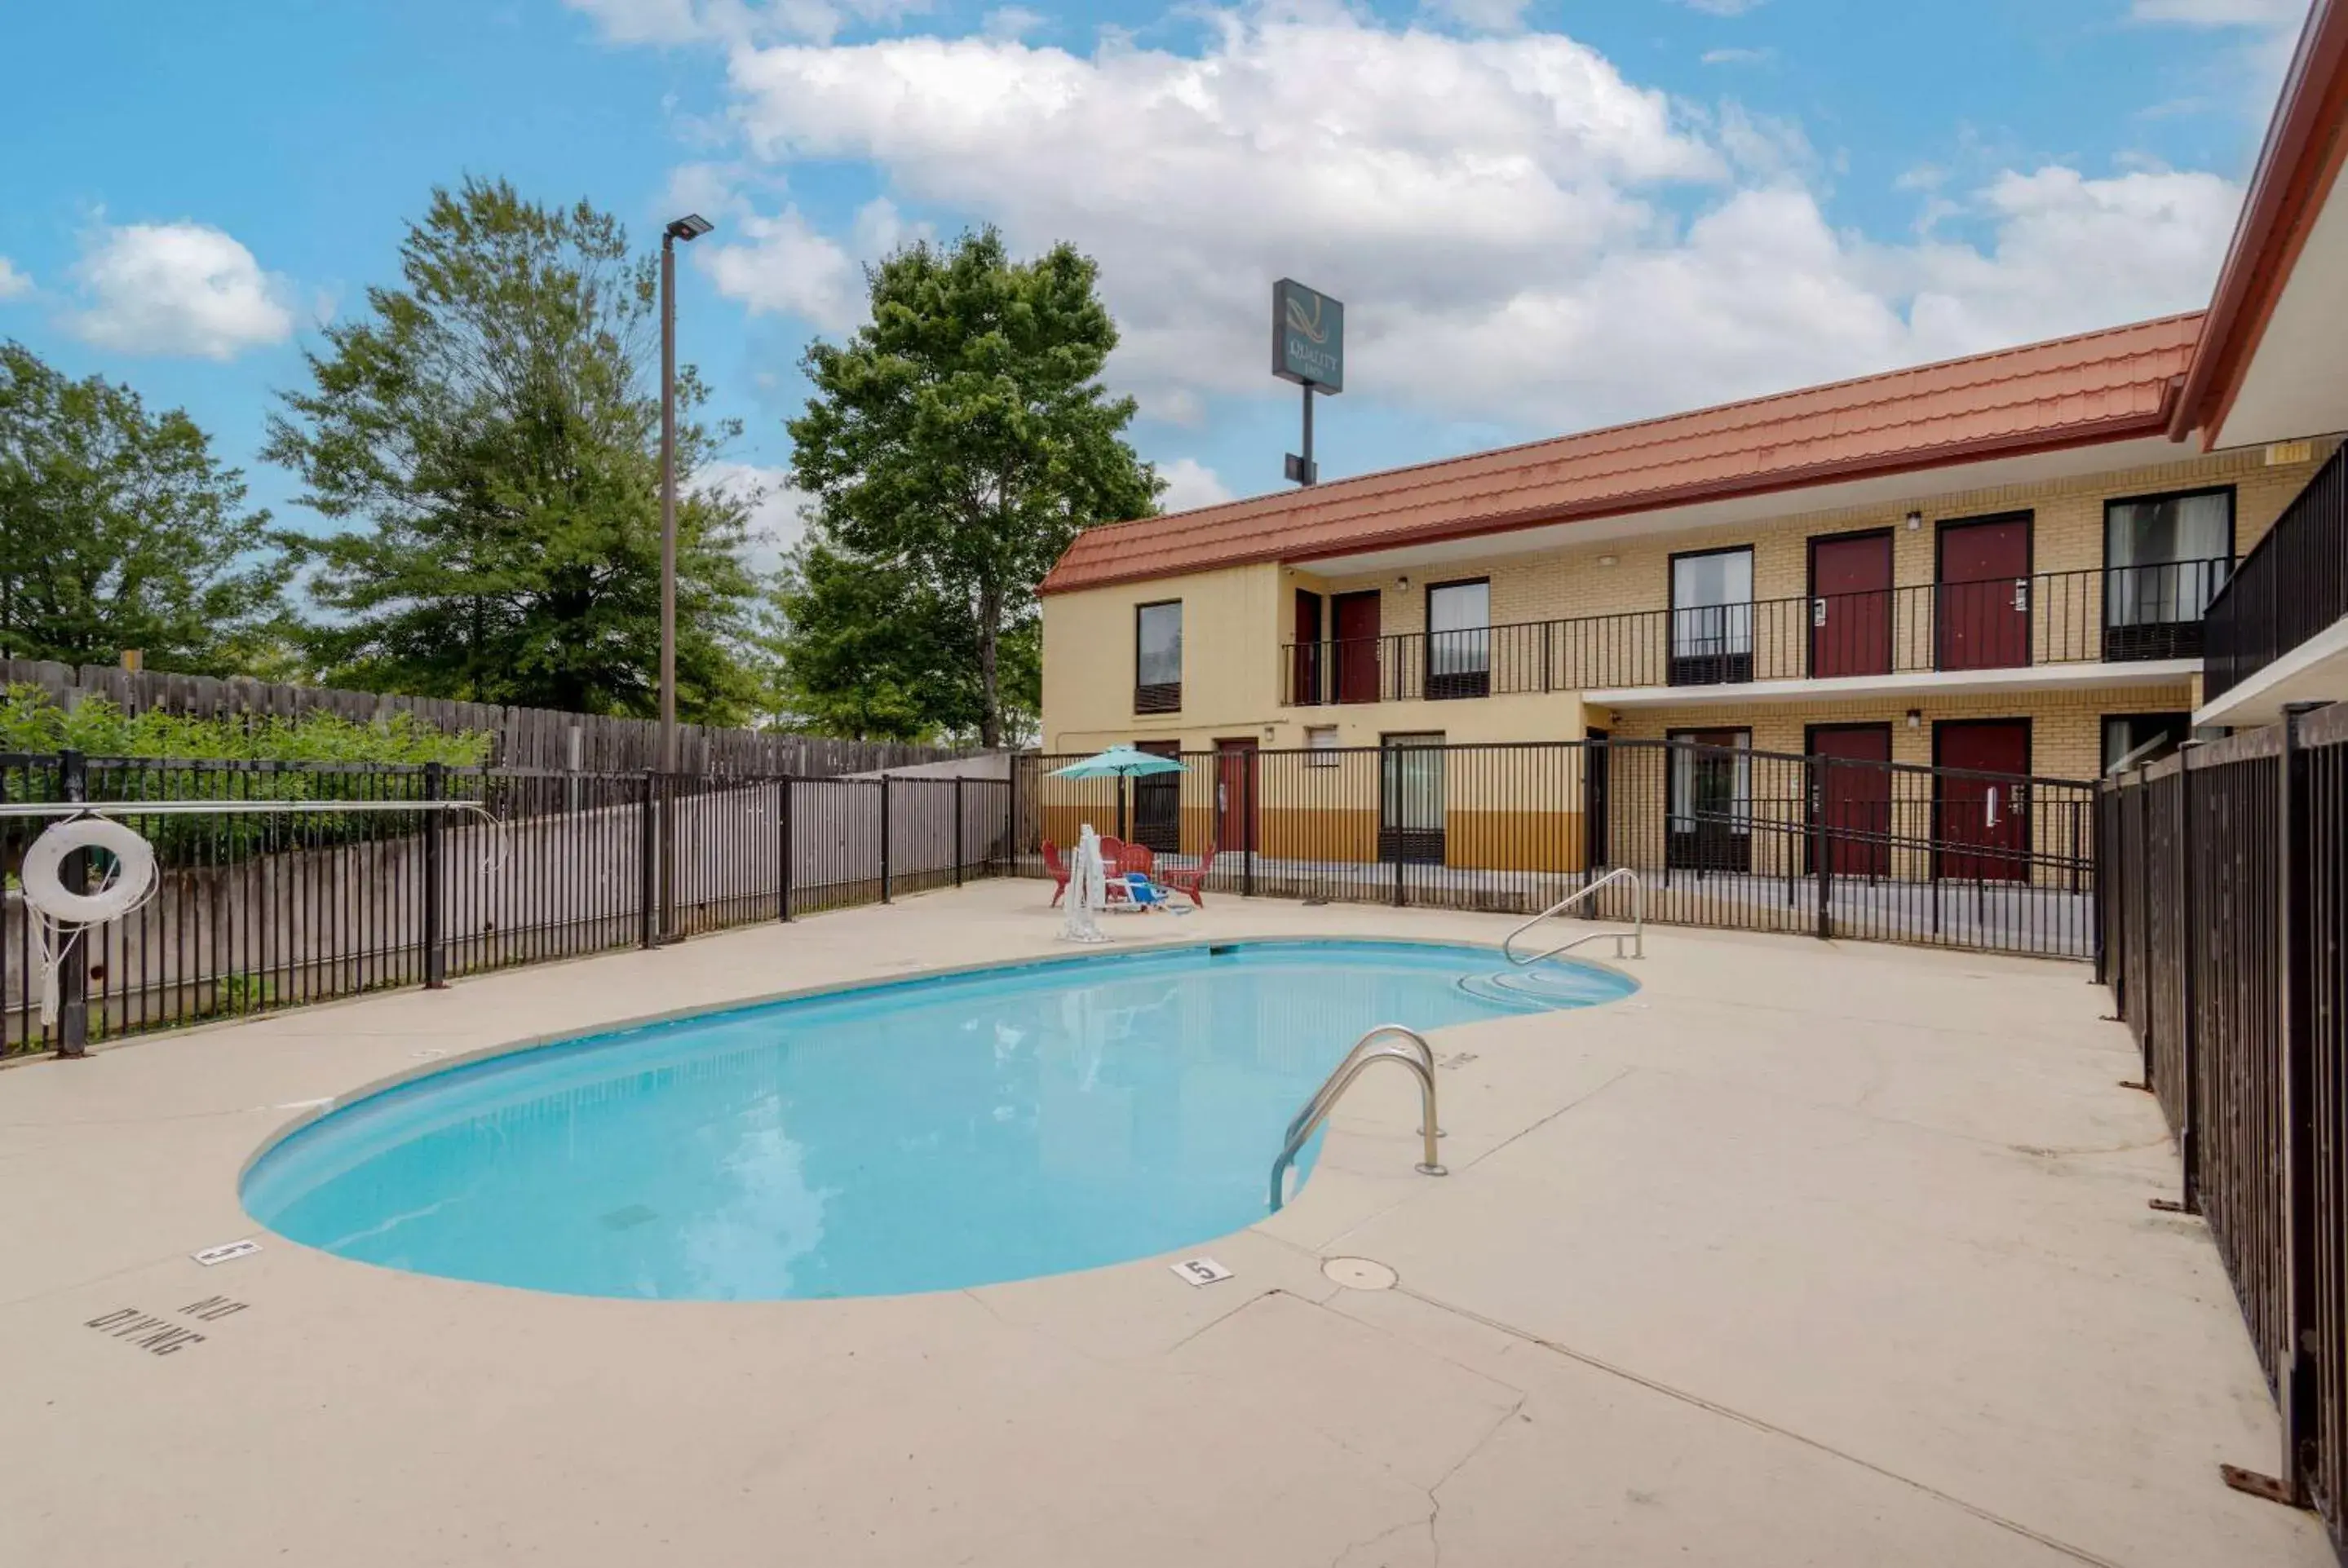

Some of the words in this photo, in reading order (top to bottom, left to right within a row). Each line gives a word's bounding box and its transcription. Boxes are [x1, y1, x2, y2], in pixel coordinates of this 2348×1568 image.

[1185, 1261, 1215, 1279] 5
[177, 1295, 250, 1321] NO
[83, 1307, 206, 1355] DIVING
